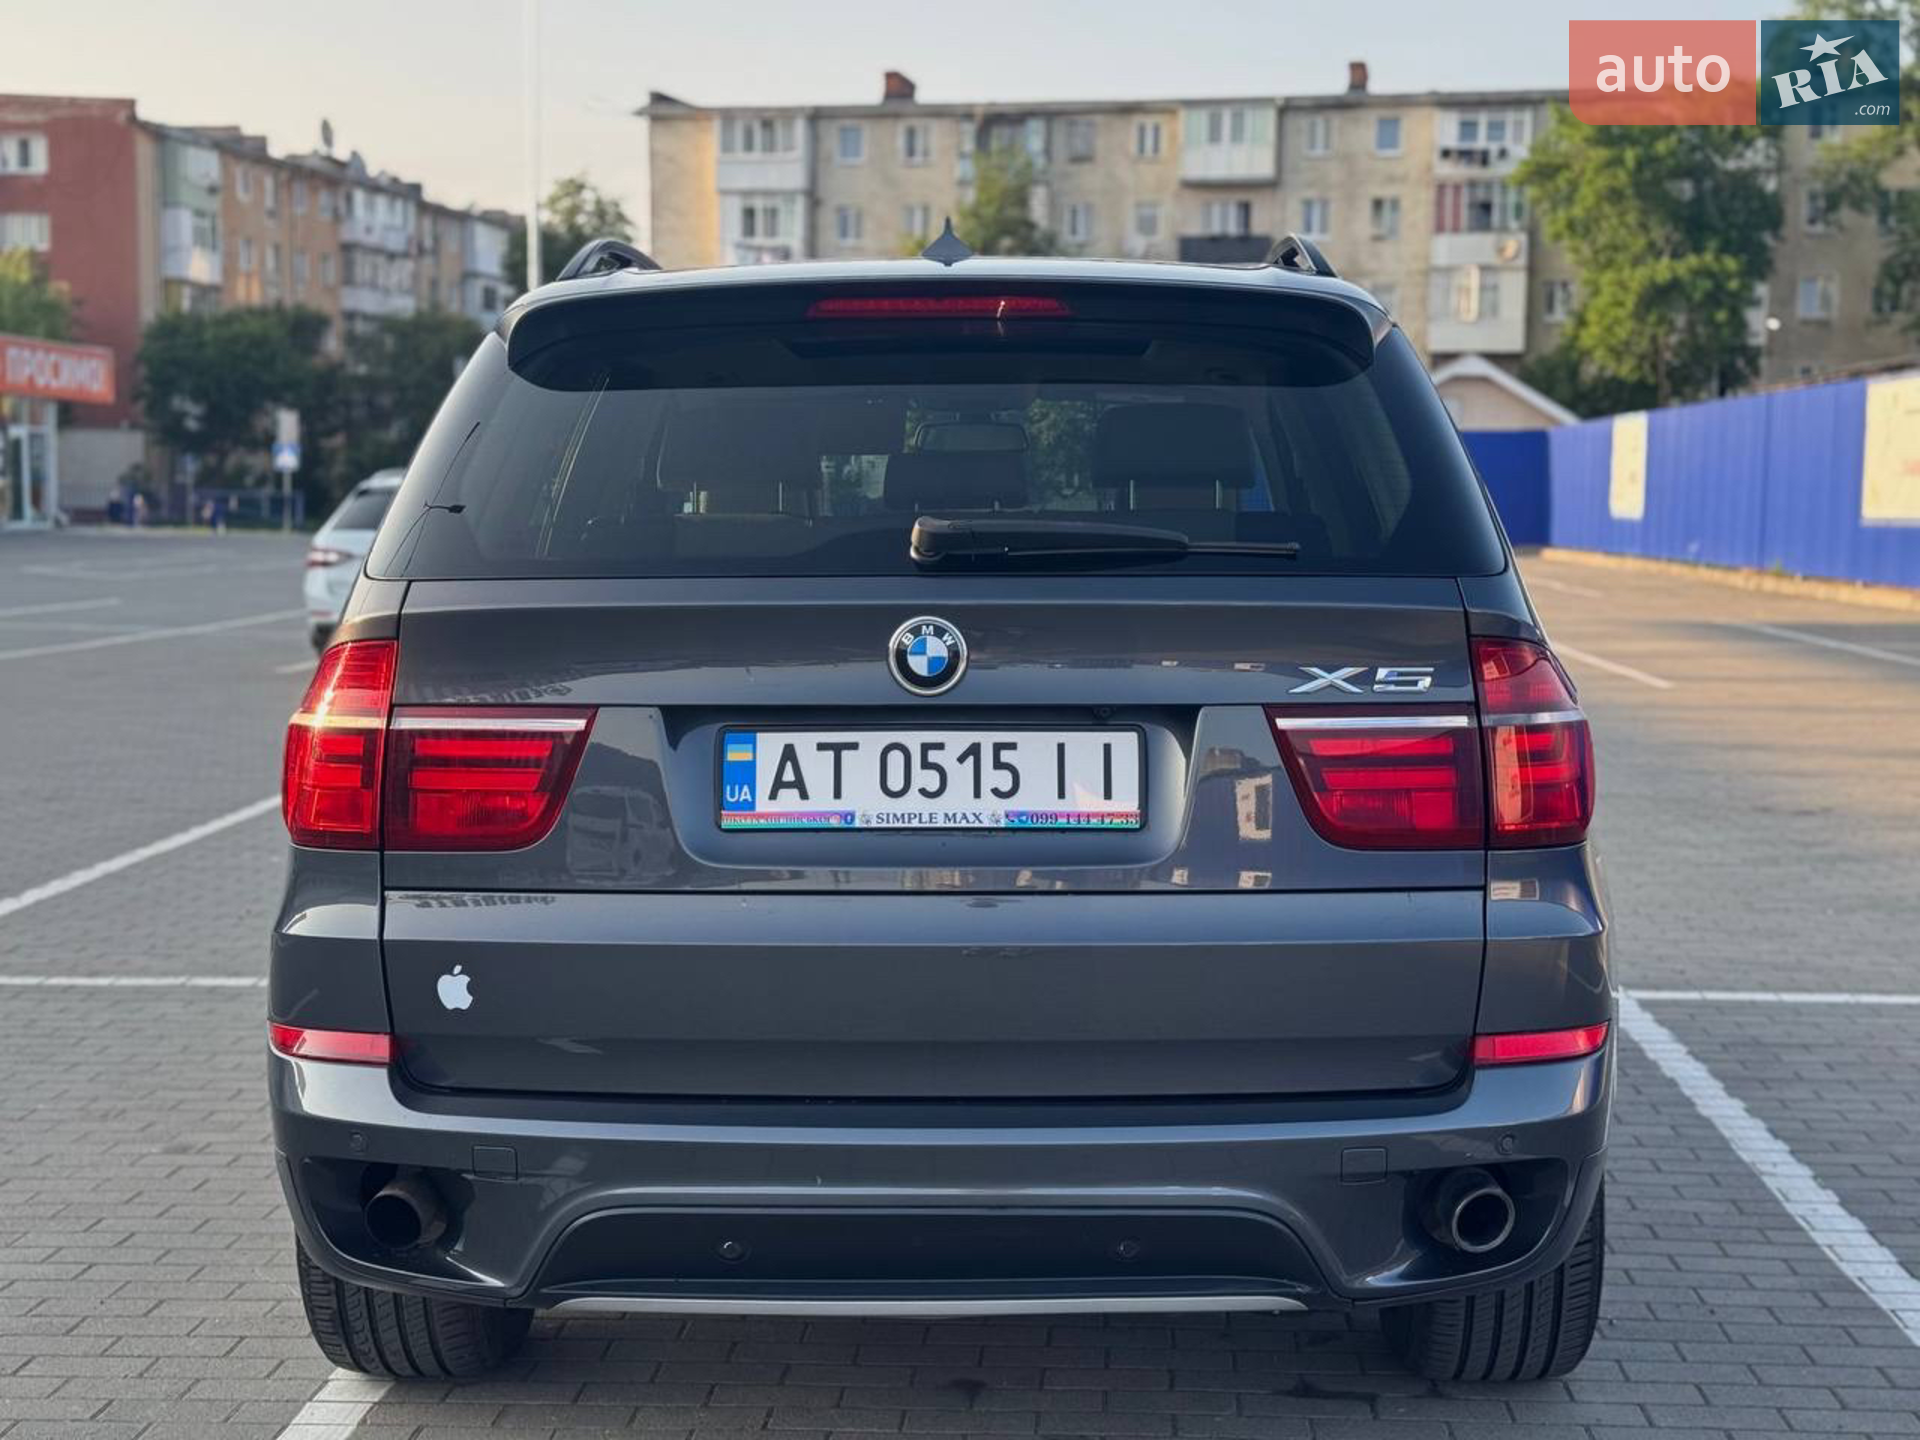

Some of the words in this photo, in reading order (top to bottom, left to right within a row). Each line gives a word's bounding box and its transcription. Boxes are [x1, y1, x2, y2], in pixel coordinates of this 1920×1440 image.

[901, 625, 956, 646] BMW
[1288, 667, 1435, 693] X5
[767, 742, 859, 800] AT
[879, 741, 1021, 800] 0515
[726, 784, 752, 802] UA
[875, 812, 938, 825] SIMPLE
[943, 812, 984, 825] MAX
